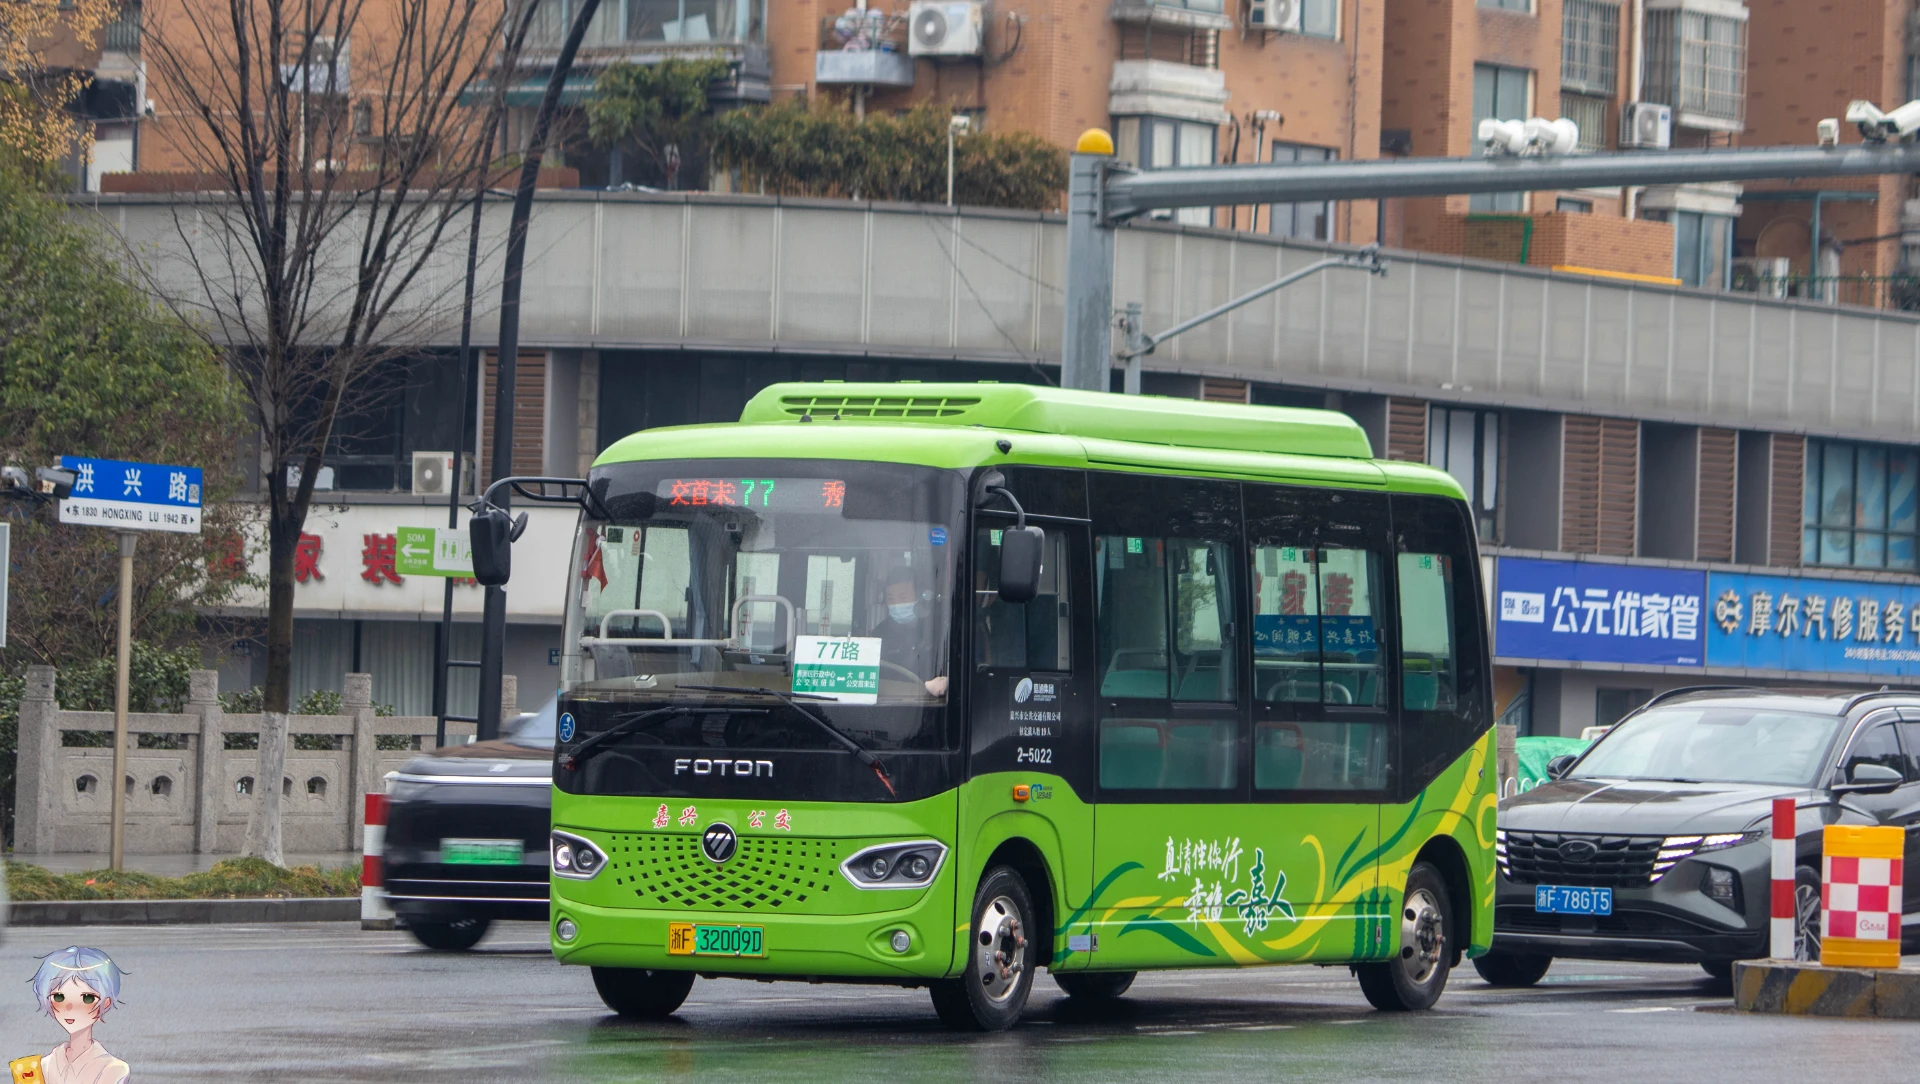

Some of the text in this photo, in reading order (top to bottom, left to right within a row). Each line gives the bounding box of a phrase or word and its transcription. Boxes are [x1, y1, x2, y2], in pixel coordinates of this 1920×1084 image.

[75, 463, 188, 502] 洪兴路
[741, 480, 774, 506] 77
[821, 480, 846, 508] 秀
[71, 505, 188, 524] 东 1830 HONGXING LU 1942 西
[406, 533, 426, 542] 50M
[1551, 586, 1700, 640] 公元优家管
[817, 641, 859, 661] 77路
[1017, 747, 1052, 763] 2-5022
[674, 758, 774, 778] FOTON
[652, 803, 791, 831] 嘉兴 公交
[1157, 835, 1244, 884] 真情伴你行
